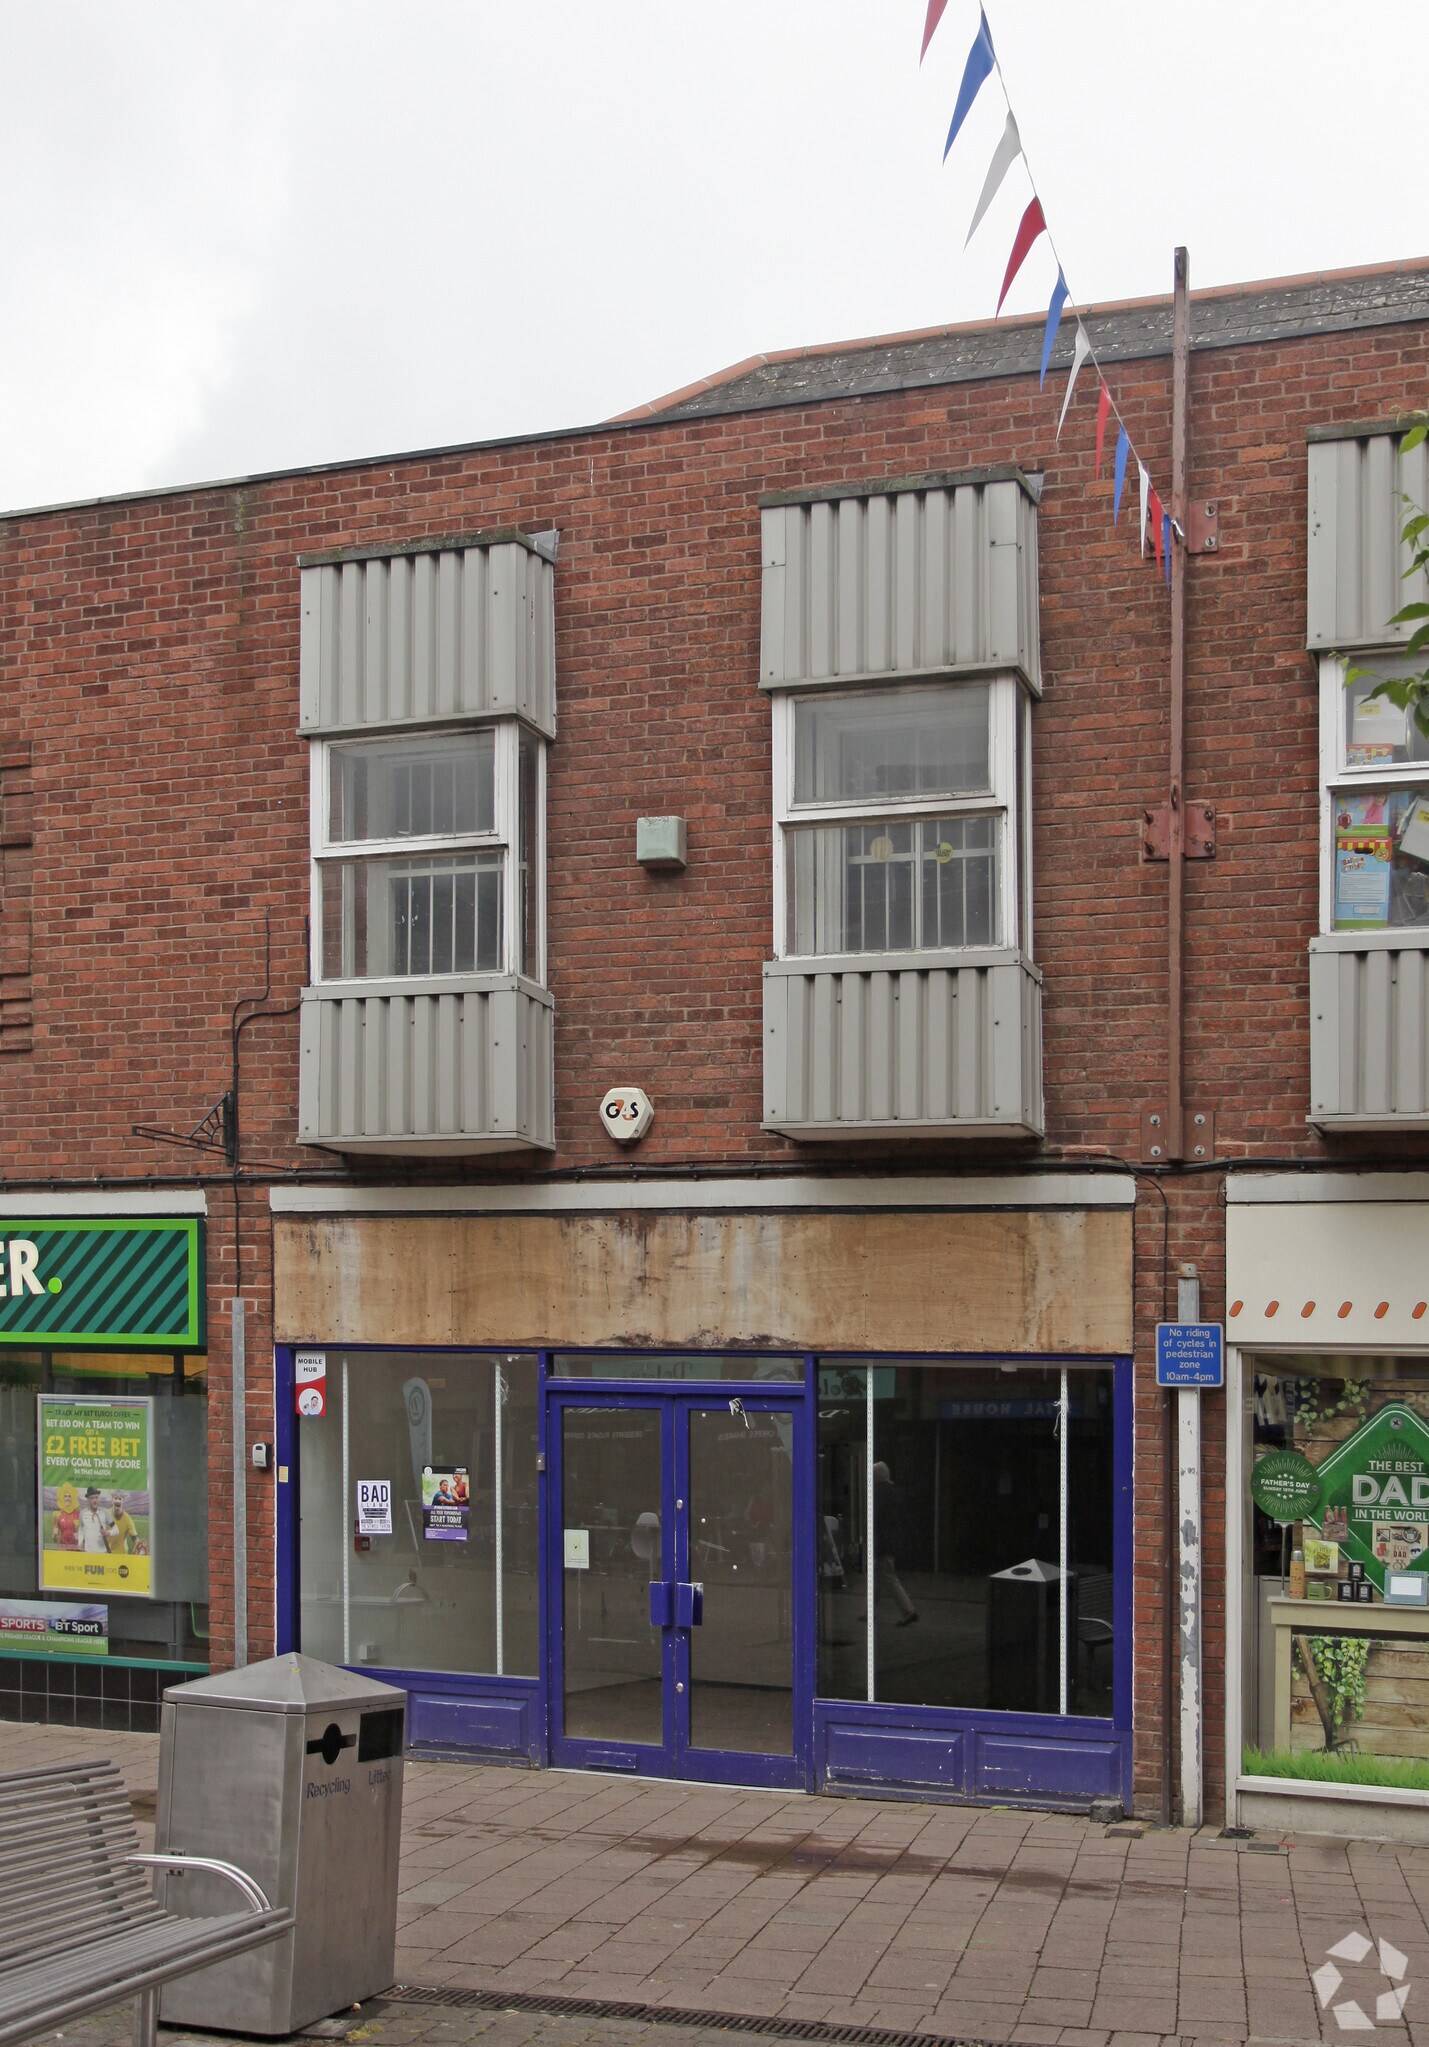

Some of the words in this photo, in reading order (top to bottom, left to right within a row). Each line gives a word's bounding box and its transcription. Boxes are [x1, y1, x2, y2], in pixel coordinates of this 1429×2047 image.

[1169, 1328, 1182, 1337] No
[1186, 1328, 1210, 1338] riding
[1163, 1338, 1172, 1347] of
[1177, 1339, 1205, 1349] cycles
[1209, 1339, 1216, 1348] in
[1166, 1350, 1214, 1359] pedestrian
[1179, 1361, 1200, 1369] zone
[1166, 1372, 1214, 1382] 10am-4pm
[46, 1419, 58, 1427] BET
[59, 1419, 71, 1428] £10
[72, 1420, 84, 1428] ON
[85, 1420, 91, 1428] A
[92, 1421, 112, 1429] TEAM
[113, 1421, 123, 1429] TO
[125, 1422, 140, 1430] WIN
[46, 1435, 65, 1455] £2
[69, 1436, 106, 1456] FREE
[110, 1437, 141, 1457] BET
[46, 1456, 70, 1466] EVERY
[71, 1457, 92, 1467] GOAL
[94, 1459, 114, 1468] THEY
[115, 1459, 141, 1469] SCORE
[1368, 1460, 1392, 1471] THE
[1395, 1461, 1424, 1472] BEST
[1260, 1479, 1294, 1487] FATHER'S
[1295, 1481, 1310, 1489] DAY
[361, 1485, 389, 1503] BAD
[1353, 1474, 1429, 1507] DAD
[430, 1515, 446, 1523] START
[446, 1516, 462, 1524] TODAY
[1355, 1509, 1367, 1519] IN
[1369, 1509, 1392, 1520] THE
[1393, 1510, 1429, 1521] WORL
[84, 1564, 105, 1575] FUN
[1, 1617, 45, 1630] SPORTS
[55, 1621, 71, 1631] BT
[71, 1621, 99, 1633] Sport
[368, 1769, 392, 1785] Litter
[306, 1777, 351, 1799] Recycling
